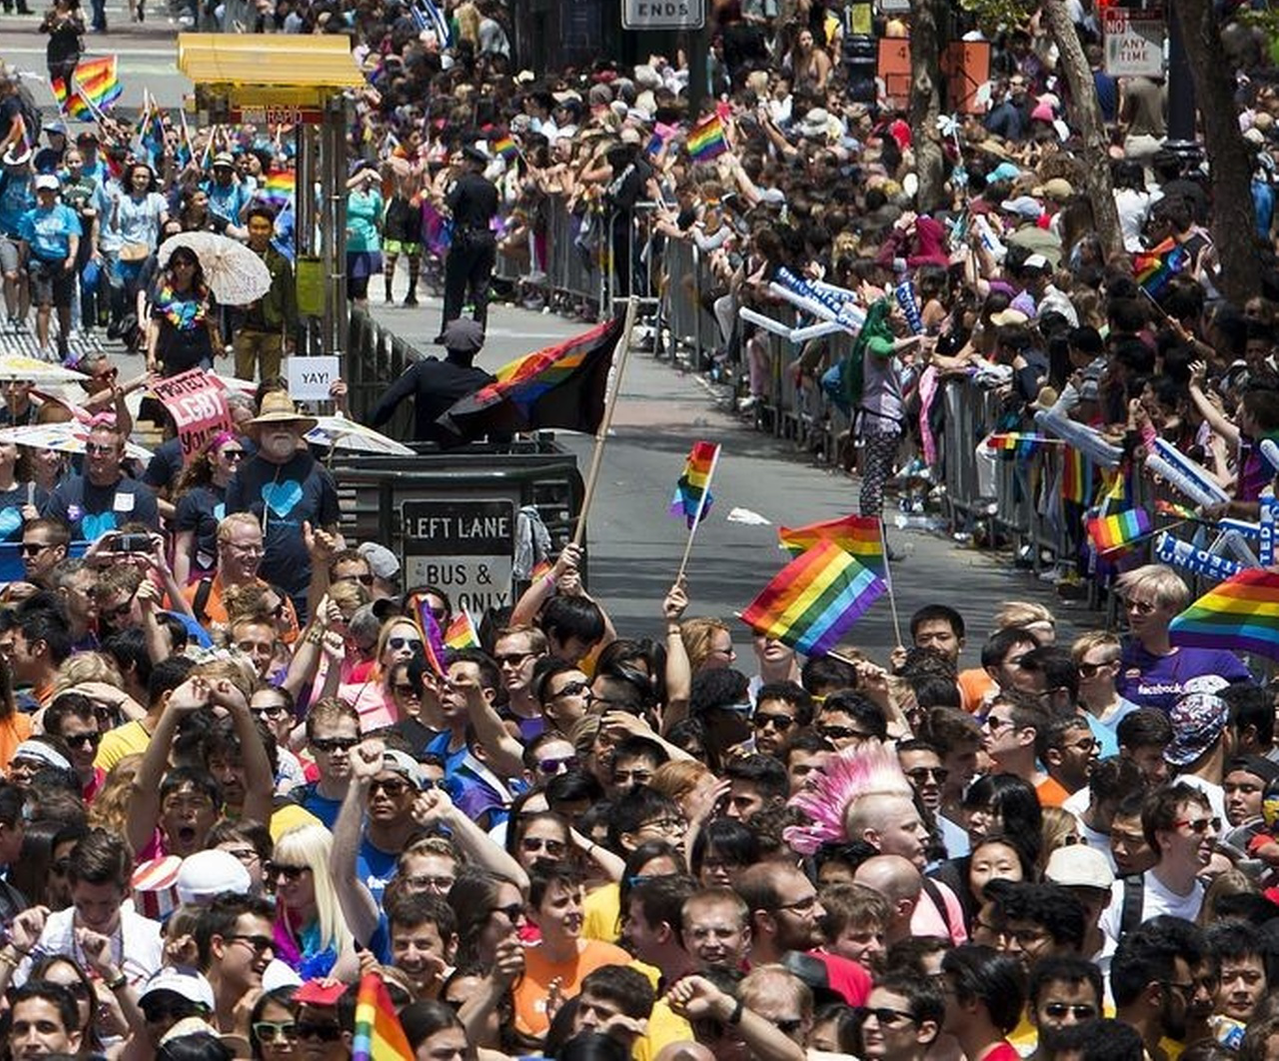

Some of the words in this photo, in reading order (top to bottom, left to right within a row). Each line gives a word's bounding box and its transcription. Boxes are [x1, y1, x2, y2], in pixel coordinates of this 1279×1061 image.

[638, 4, 689, 17] ENDS
[1106, 21, 1125, 34] NO
[1123, 40, 1147, 49] ANY
[1122, 51, 1147, 61] TIME
[302, 372, 330, 385] YAY!
[153, 371, 210, 400] PROTECT
[168, 391, 225, 428] LGBT
[406, 517, 452, 539] LEFT
[458, 517, 511, 539] LANE
[426, 564, 468, 585] BUS
[476, 564, 493, 585] &
